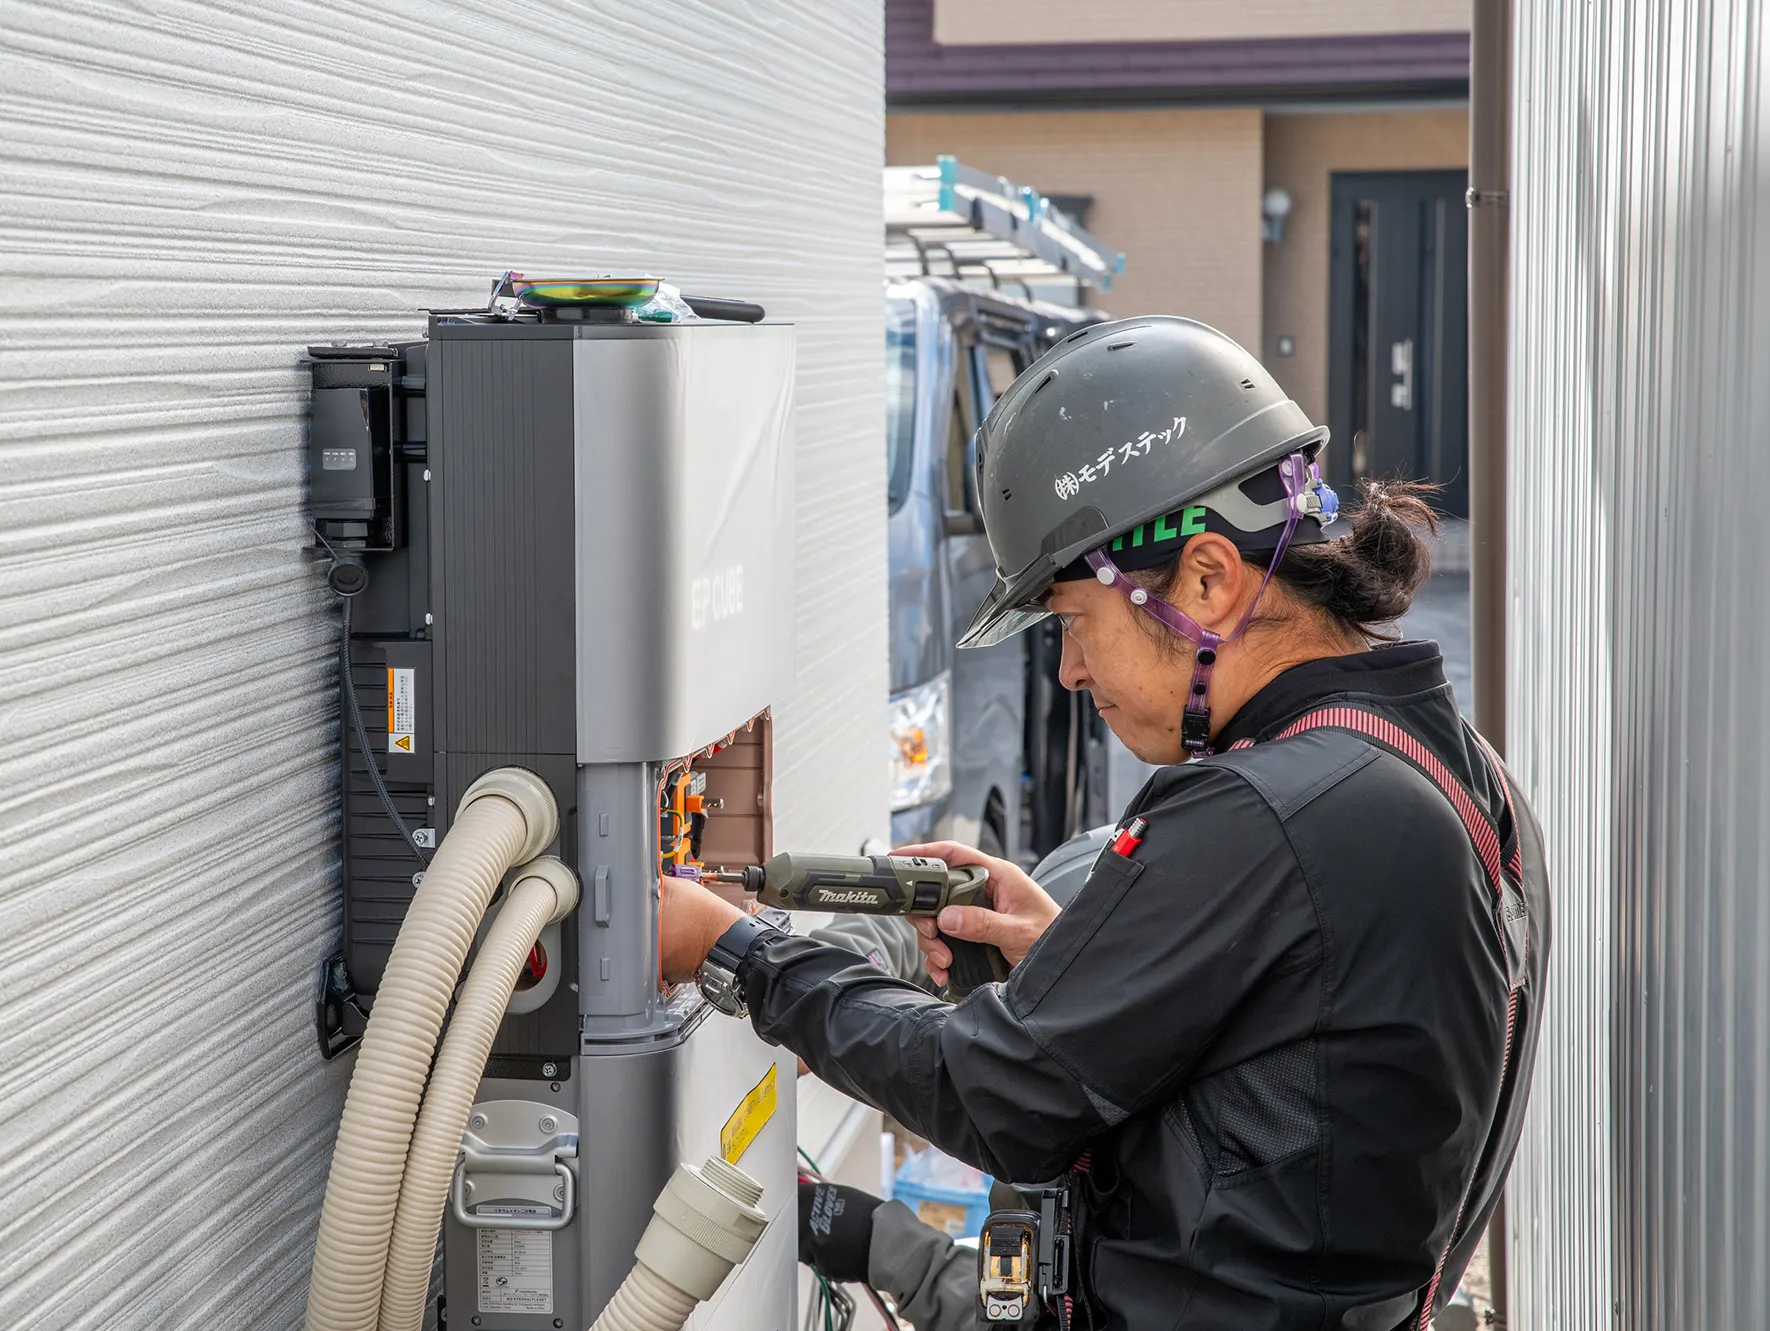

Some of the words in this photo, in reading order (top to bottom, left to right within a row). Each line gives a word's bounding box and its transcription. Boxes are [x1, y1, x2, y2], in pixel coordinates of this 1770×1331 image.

[1112, 505, 1206, 551] LE
[692, 578, 711, 630] EP
[713, 565, 743, 621] CUBE
